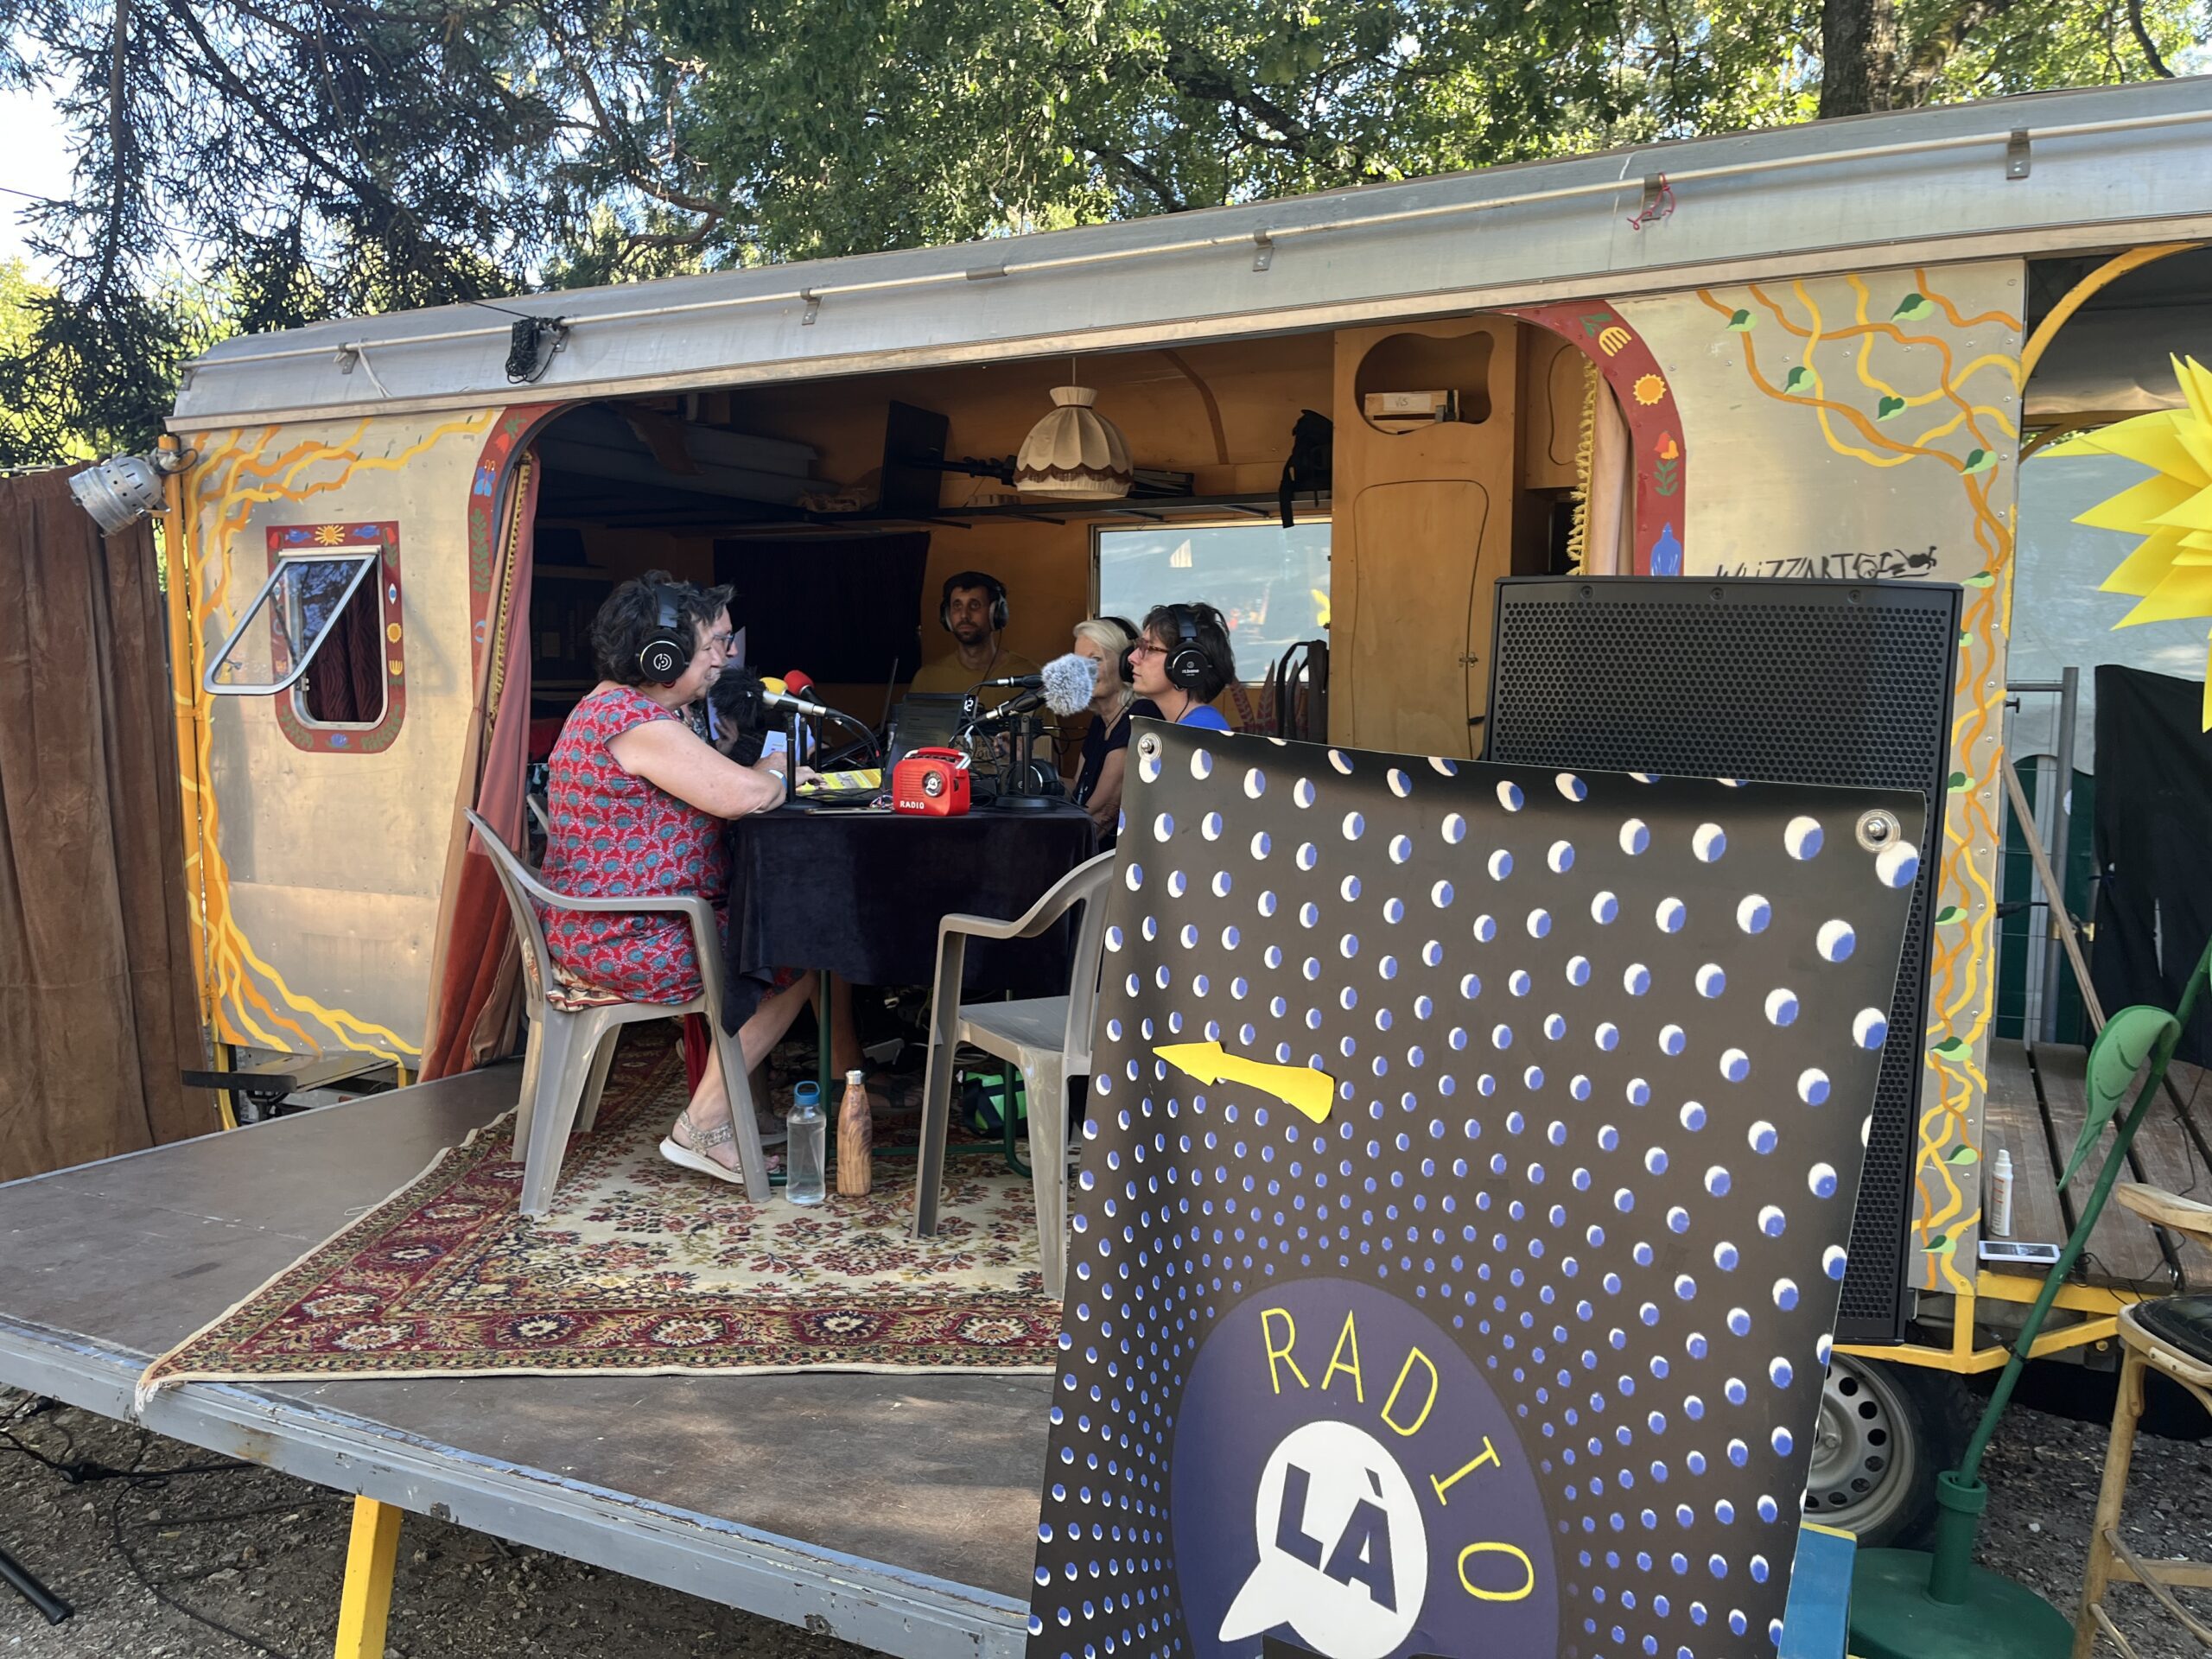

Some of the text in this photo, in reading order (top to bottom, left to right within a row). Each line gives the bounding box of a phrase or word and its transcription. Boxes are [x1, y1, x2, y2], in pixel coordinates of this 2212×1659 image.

[899, 800, 925, 810] RADIO
[1261, 1307, 1535, 1602] RADIO
[1274, 1462, 1398, 1615] LÀ
